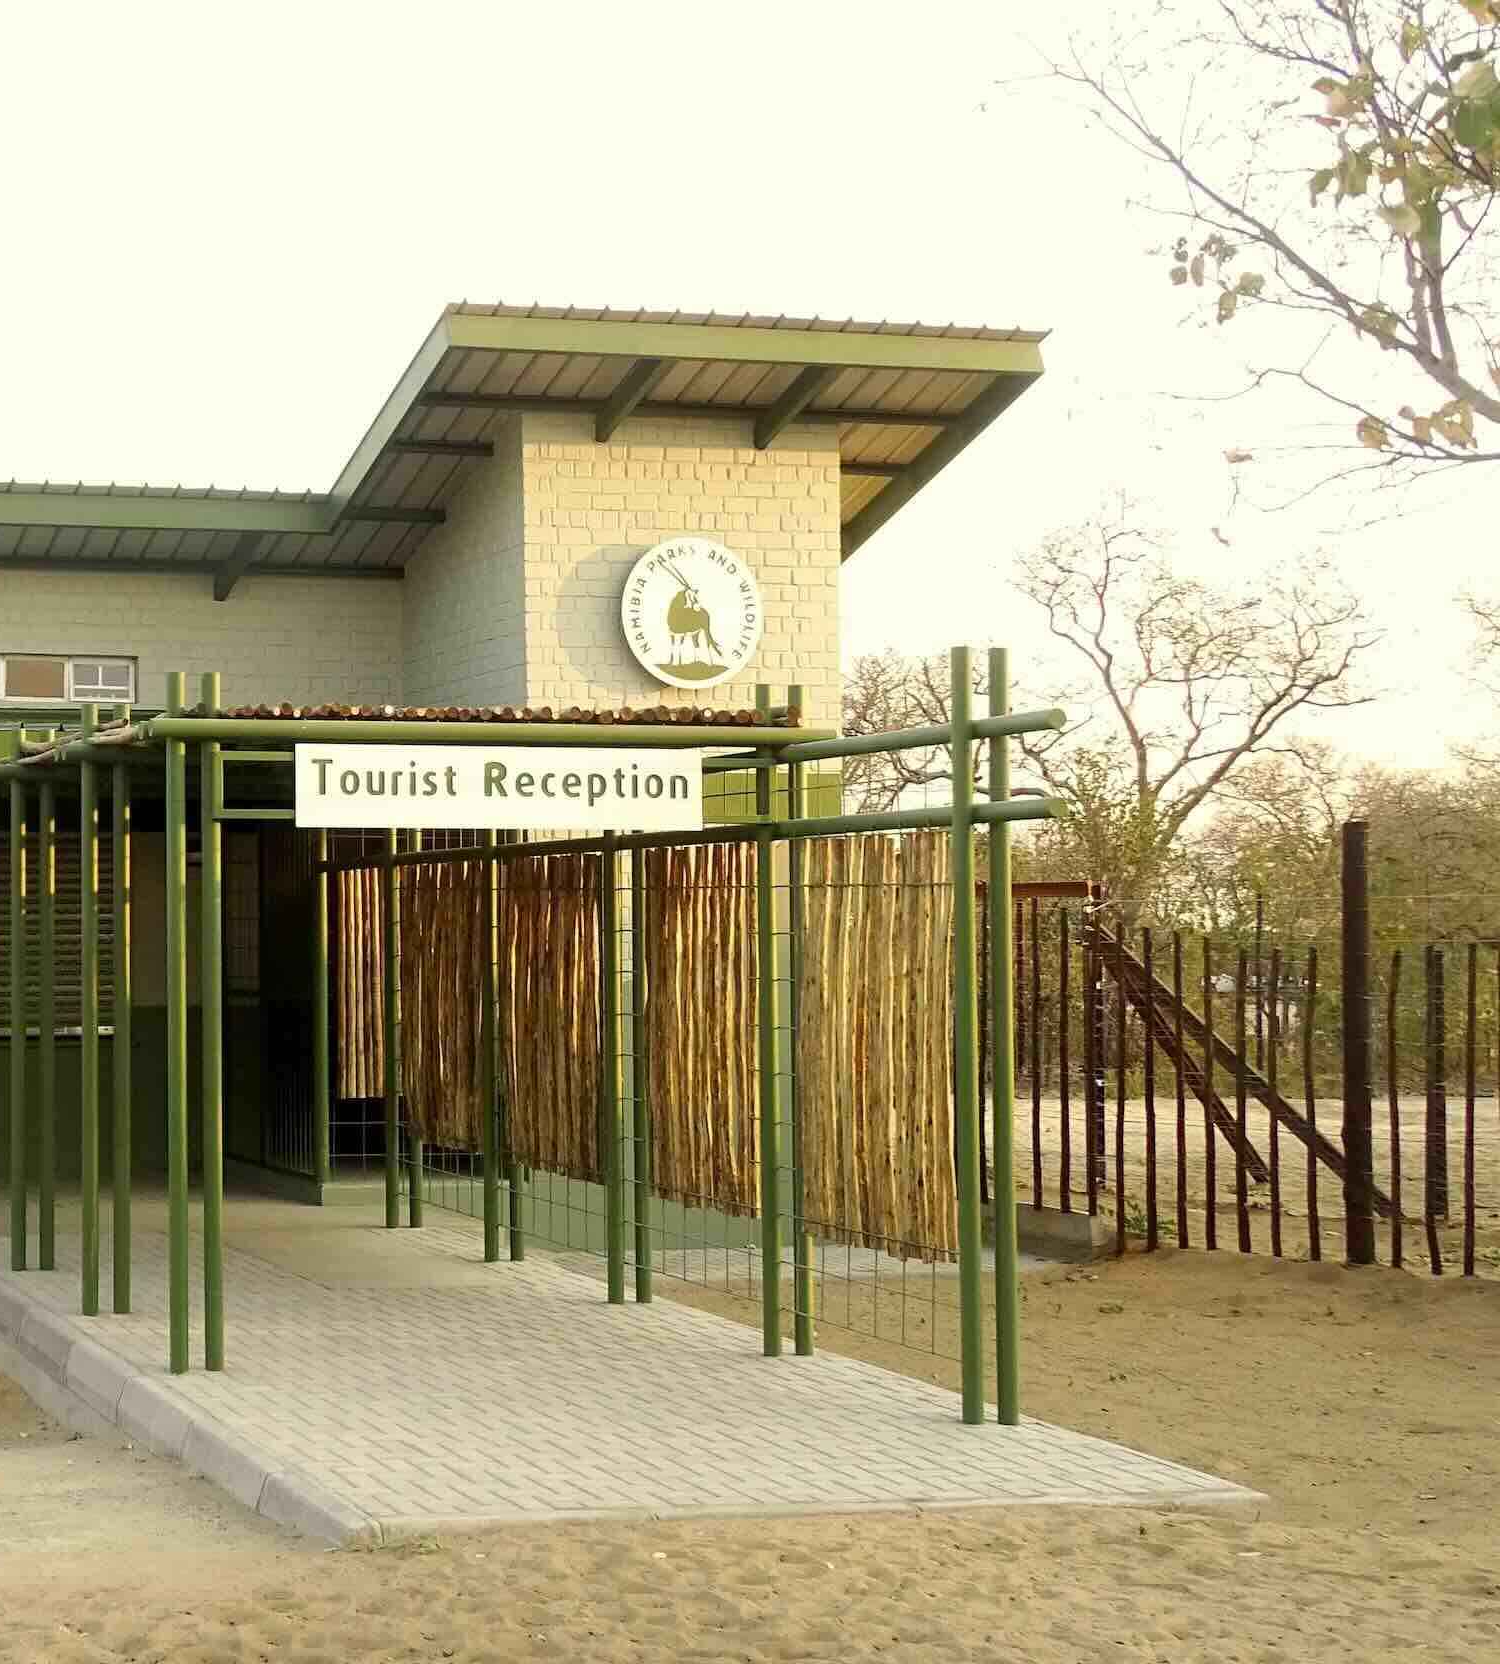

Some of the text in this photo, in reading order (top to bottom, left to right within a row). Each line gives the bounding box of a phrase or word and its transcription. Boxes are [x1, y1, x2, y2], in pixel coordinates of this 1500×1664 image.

[630, 545, 757, 660] NAMIBIA PARKS AND WILDLIFE
[311, 757, 690, 807] Tourist Reception
